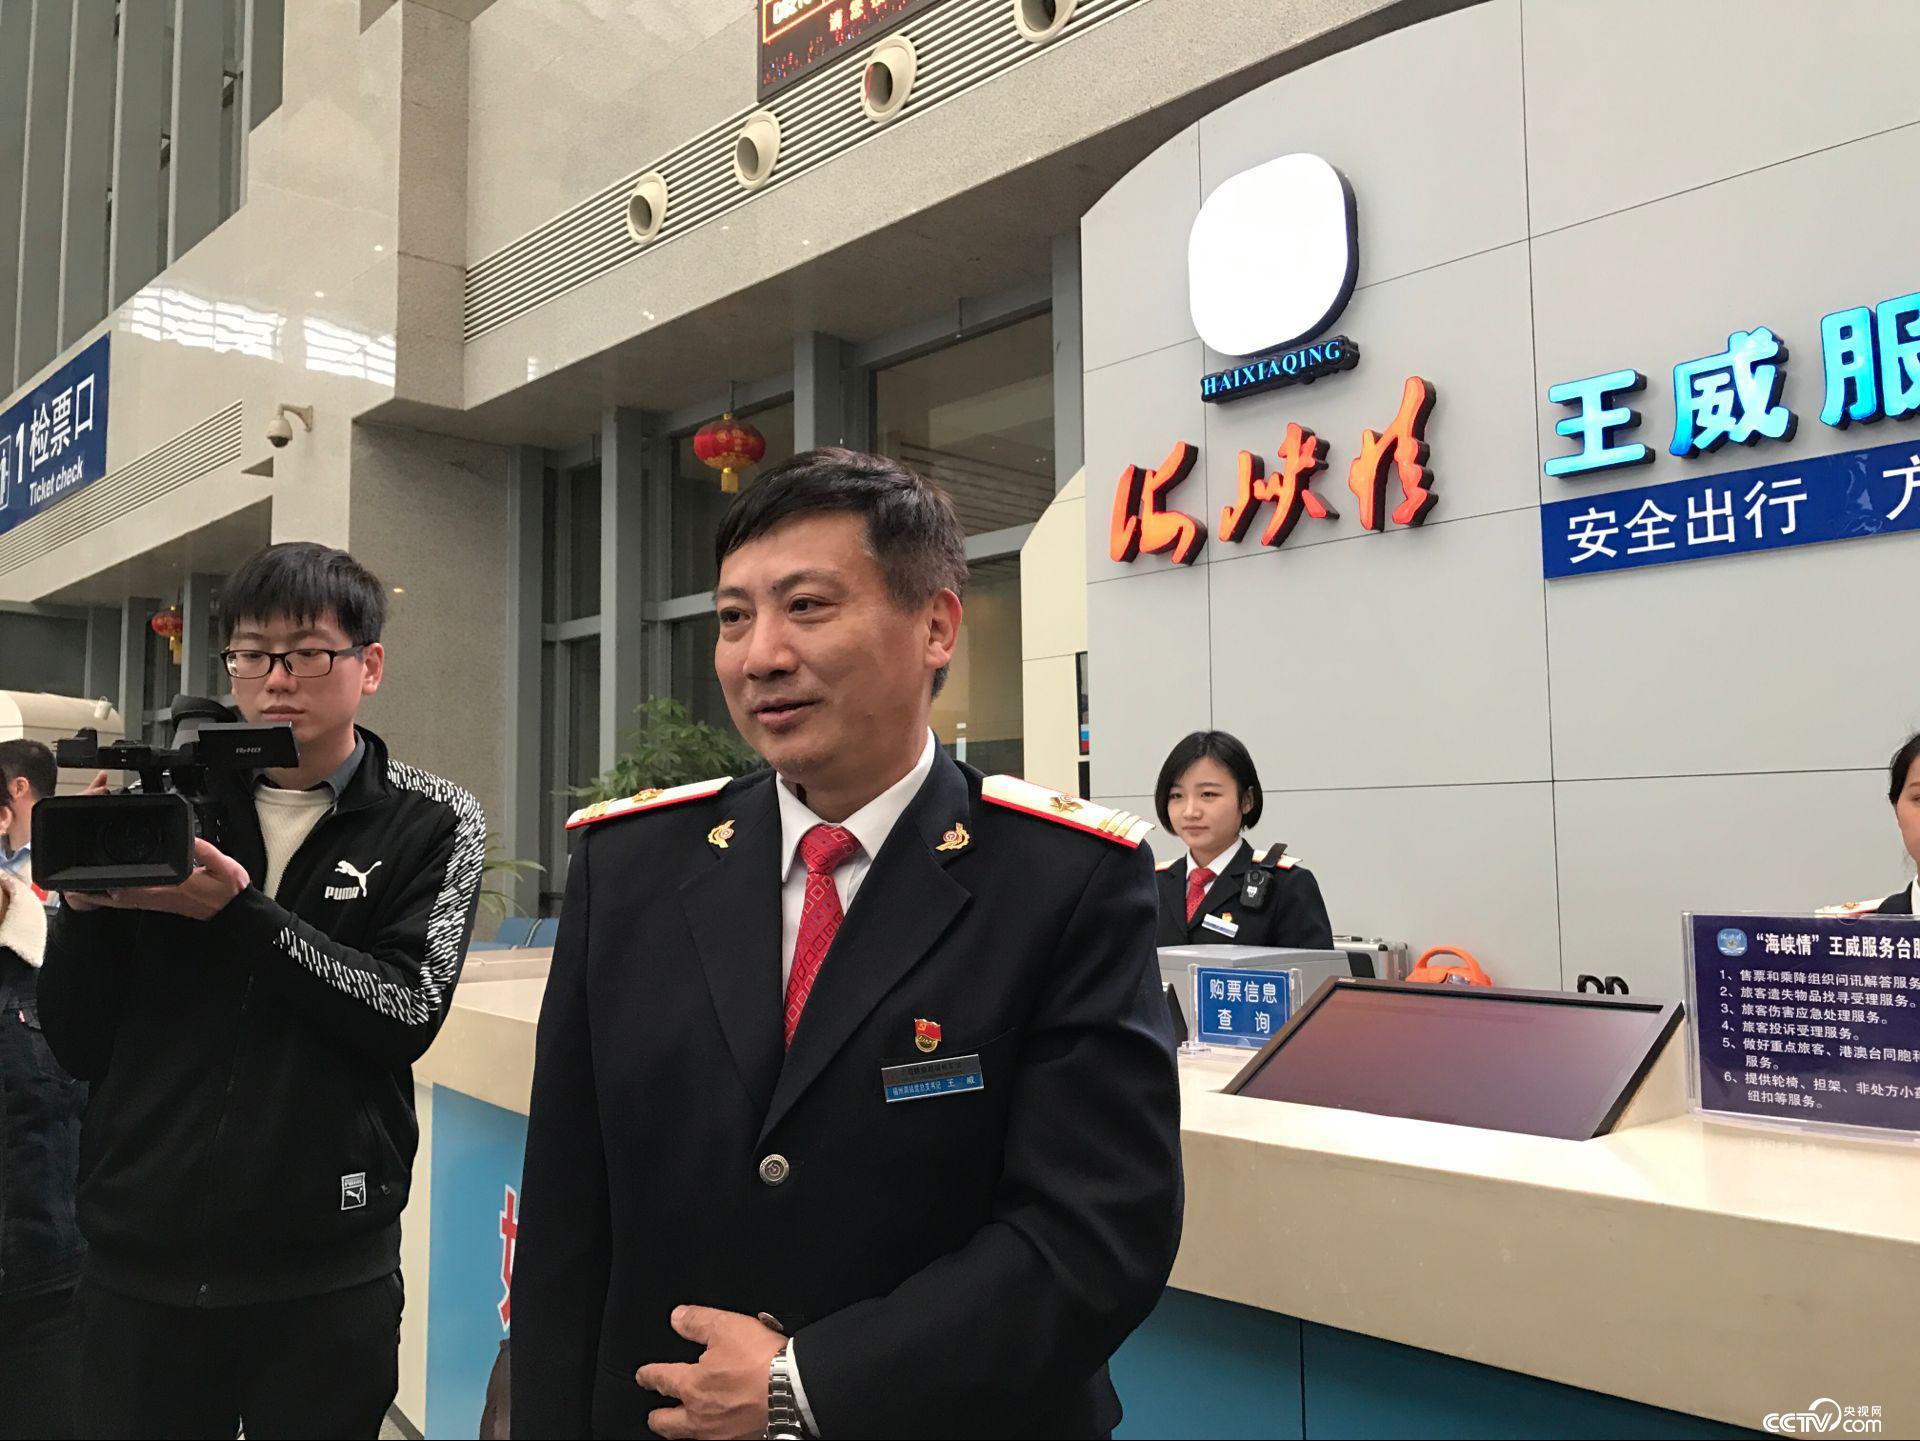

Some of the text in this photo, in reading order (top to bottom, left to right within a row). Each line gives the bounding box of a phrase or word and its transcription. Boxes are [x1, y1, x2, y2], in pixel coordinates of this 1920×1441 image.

[1203, 340, 1341, 397] HAIXIAQING
[29, 455, 84, 506] Ticket check
[1567, 477, 1808, 563] 安全出行
[324, 886, 360, 900] PUMA
[1209, 979, 1277, 1003] 购票信息
[1745, 1055, 1779, 1070] 服务。
